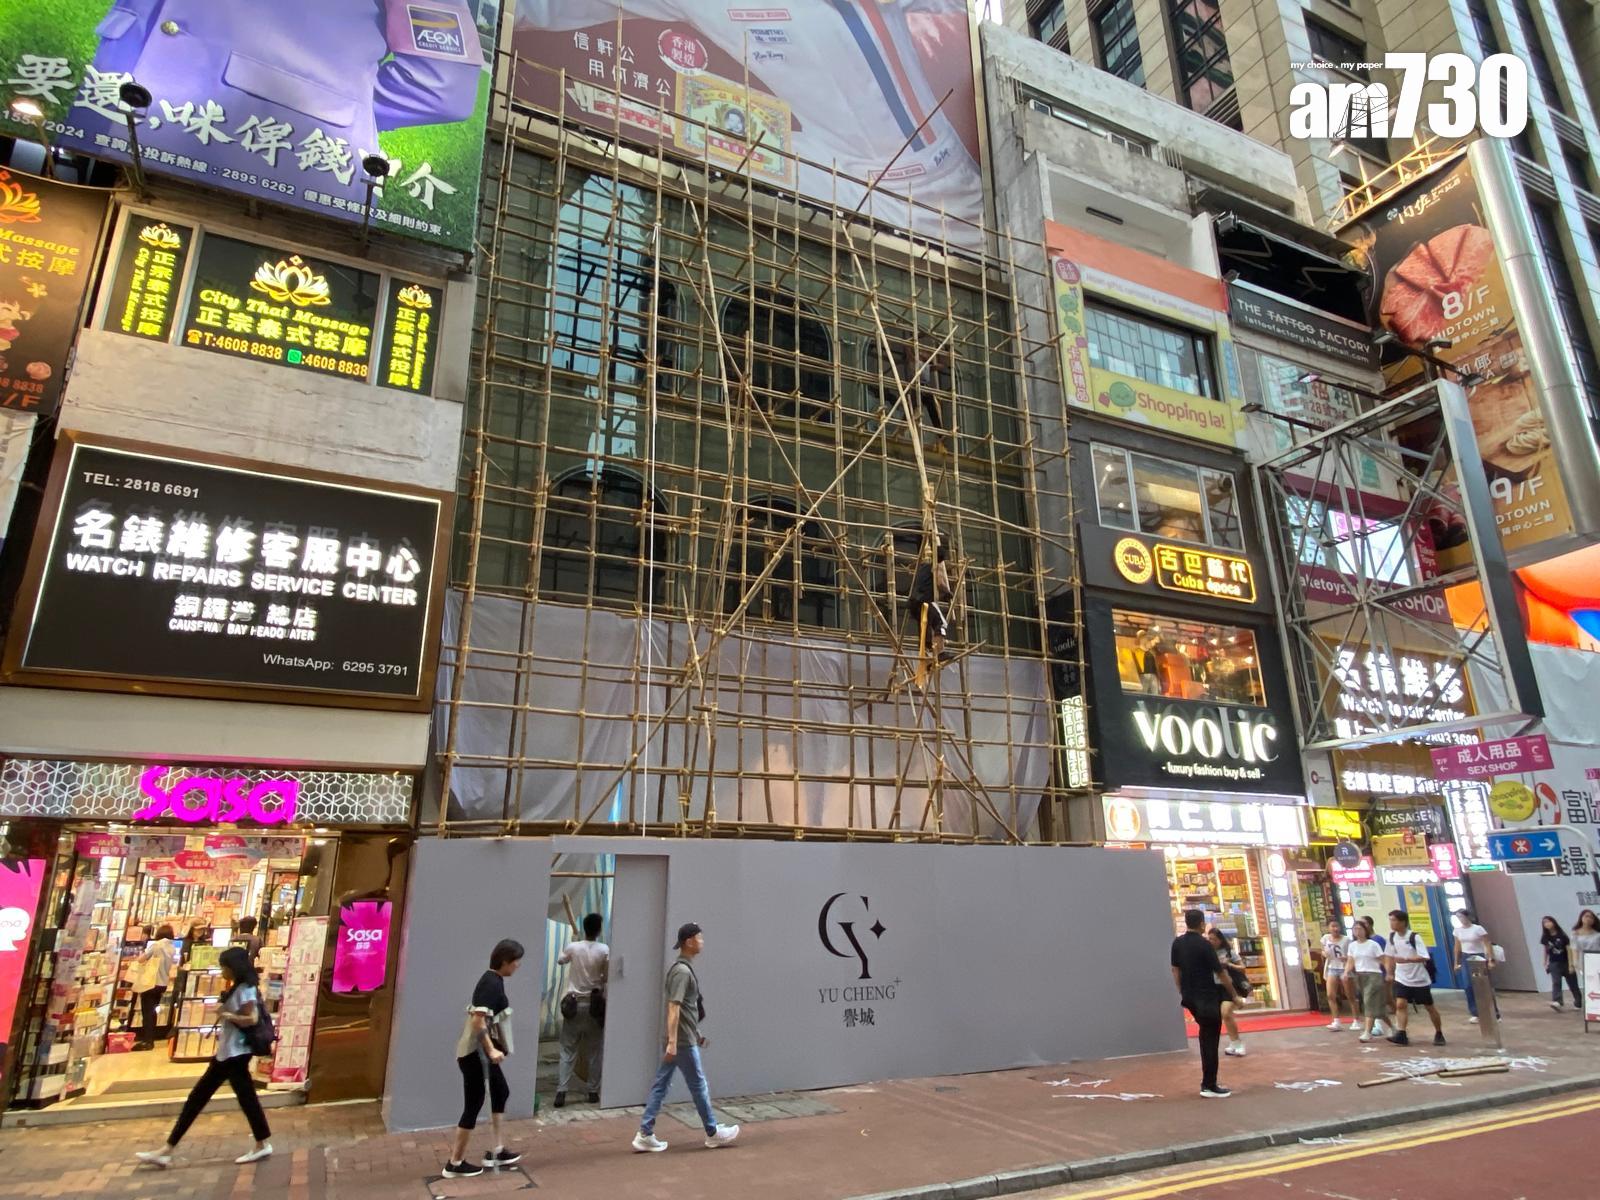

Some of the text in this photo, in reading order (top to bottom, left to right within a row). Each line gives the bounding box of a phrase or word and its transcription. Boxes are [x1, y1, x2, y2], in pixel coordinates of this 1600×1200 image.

[573, 31, 635, 64] 信軒公
[2, 110, 85, 139] 155/2024
[222, 167, 258, 186] 2895
[261, 177, 295, 195] 6262
[136, 250, 176, 336] 正宗泰式按摩
[1442, 284, 1490, 320] 8/F
[199, 289, 370, 336] City Thai Massage
[1237, 299, 1262, 316] THE
[1319, 328, 1370, 353] FACTORY
[195, 306, 367, 357] 正宗泰式按摩
[203, 334, 283, 360] T:4608 8838
[337, 359, 369, 377] 8838
[1137, 392, 1225, 429] Shopping la!
[83, 472, 200, 499] TEL: 2818 6691
[1490, 475, 1544, 506] 9/F
[72, 508, 422, 583] 名錶維修客服中心
[1123, 551, 1145, 566] CUBA
[66, 552, 418, 606] WATCH REPAIRS SERVICE CENTER
[1160, 548, 1248, 584] 古巴時代
[1173, 572, 1204, 590] Cuba
[169, 618, 224, 634] CAUSEWAY
[227, 624, 247, 637] BAY
[263, 653, 409, 677] WhatsApp: 6295 3791
[1457, 742, 1522, 764] 成人用品
[1167, 762, 1193, 777] luxury
[1193, 764, 1223, 777] fashion
[1223, 766, 1239, 780] buy
[1247, 767, 1260, 779] sell
[1467, 761, 1518, 776] SEX SHOP
[819, 985, 897, 1004] YU CHENG
[843, 1007, 875, 1028] 譽城
